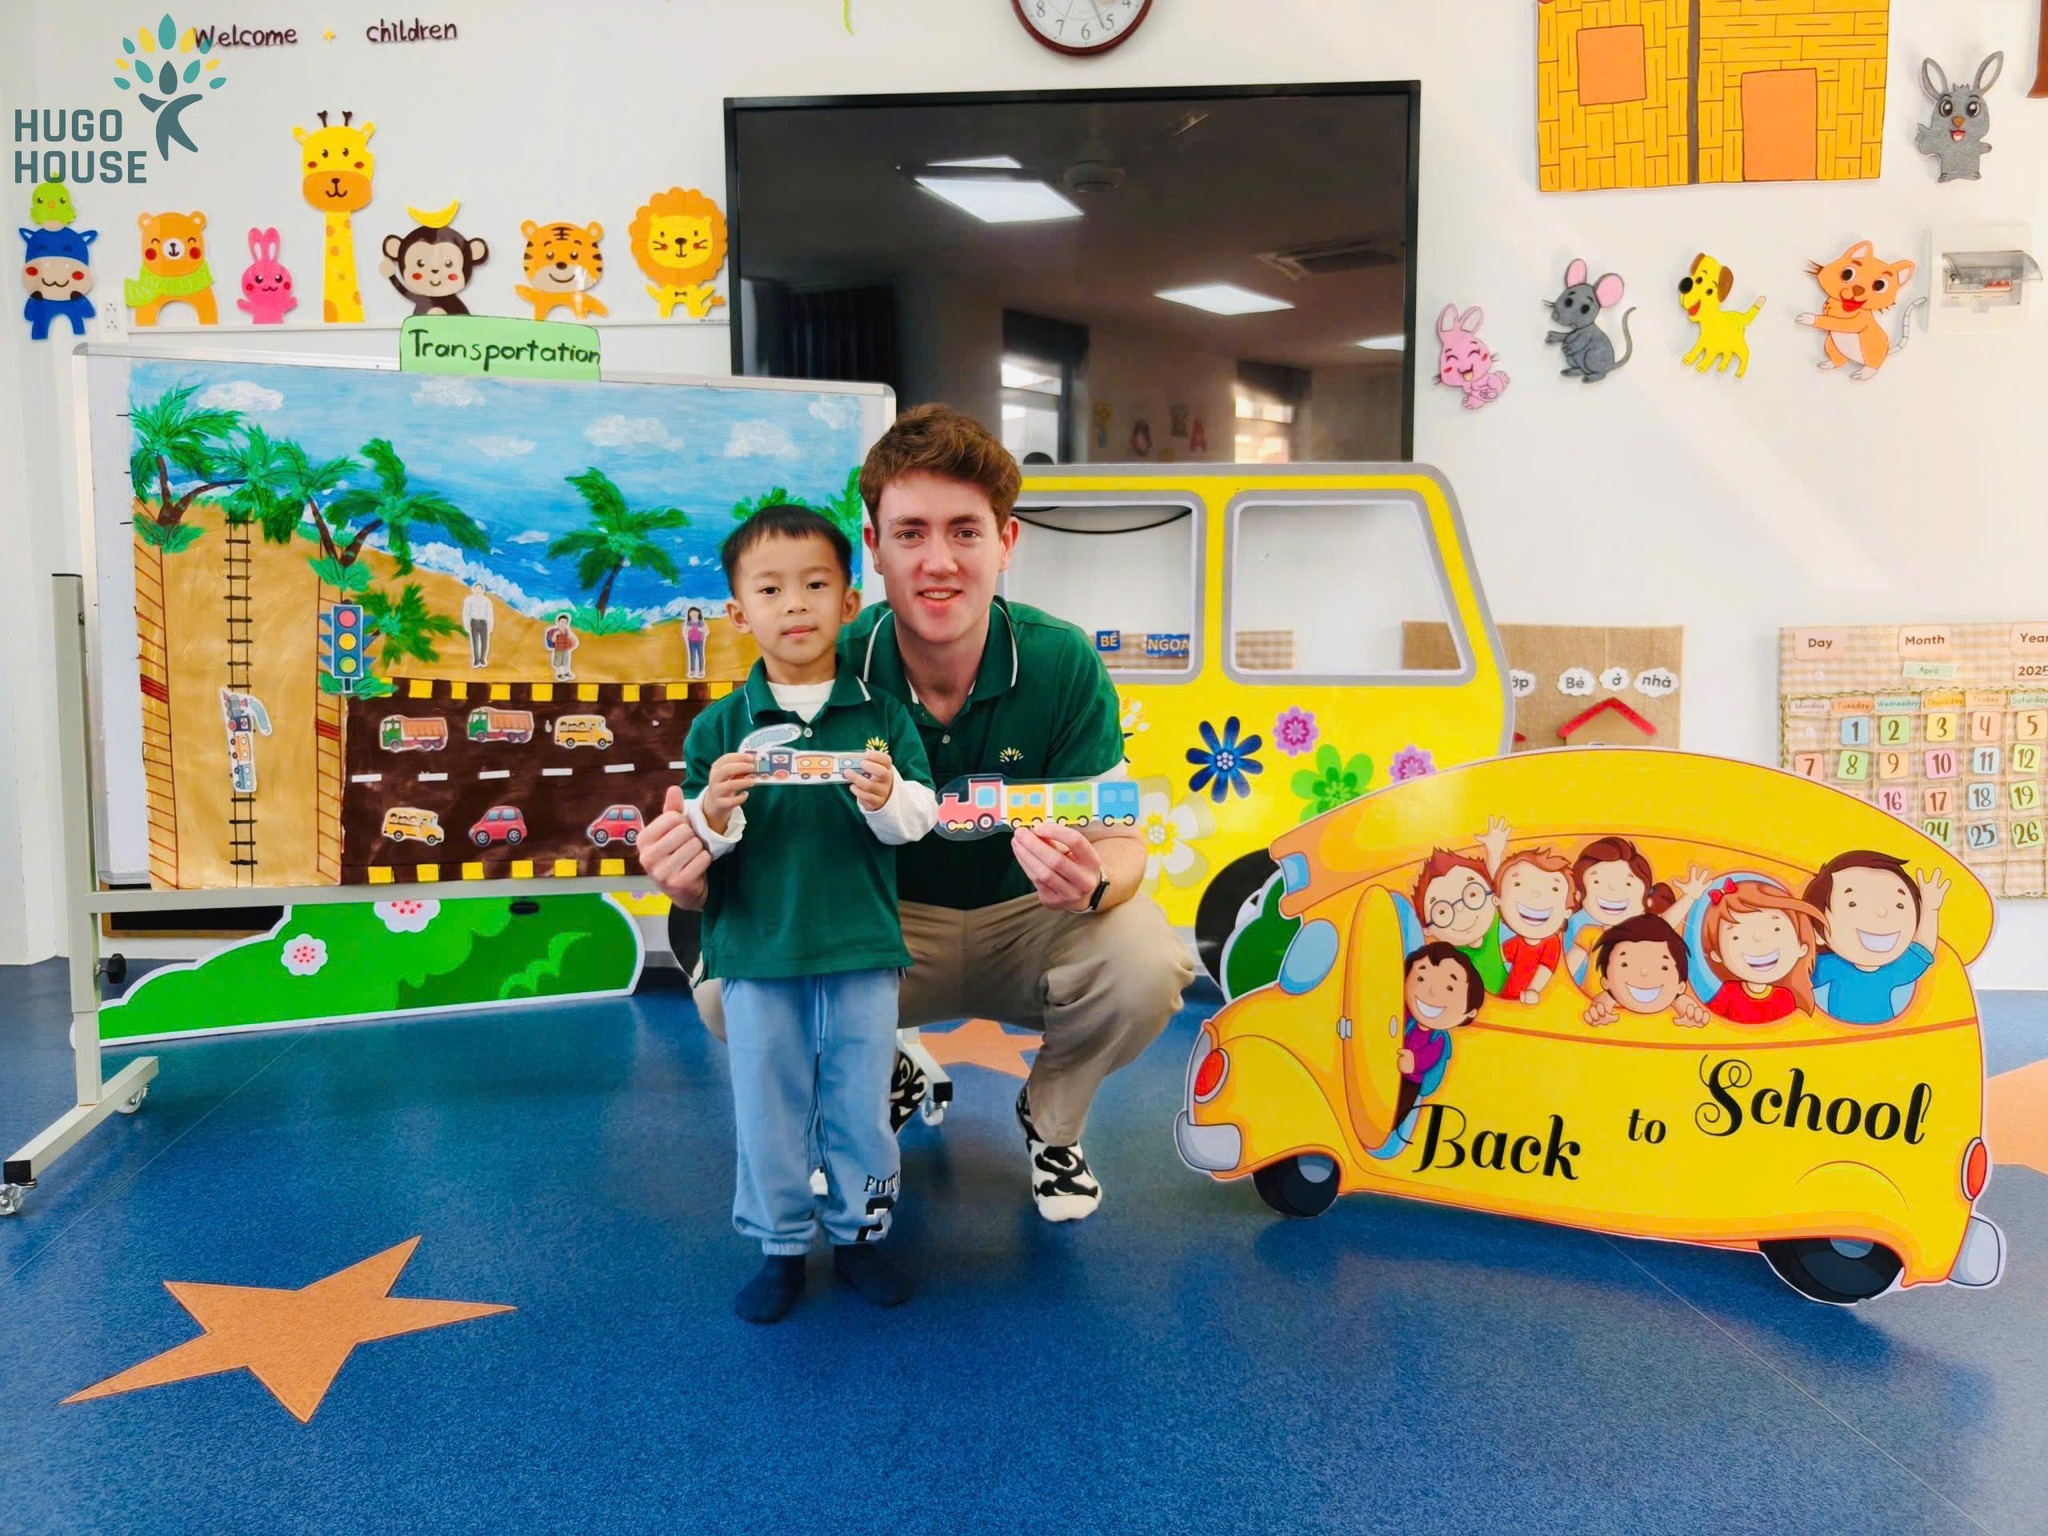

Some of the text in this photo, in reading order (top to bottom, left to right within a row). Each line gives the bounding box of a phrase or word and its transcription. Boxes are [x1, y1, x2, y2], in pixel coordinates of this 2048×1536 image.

[1036, 0, 1046, 18] 8
[1055, 19, 1065, 37] 7
[1105, 14, 1115, 31] 5
[193, 18, 458, 48] Welcome children
[1081, 23, 1091, 41] 6
[408, 329, 600, 372] Transportation
[1100, 632, 1118, 647] BÉ
[1807, 637, 1833, 650] Day
[1905, 634, 1945, 646] Month
[1918, 666, 1939, 676] April
[1512, 675, 1529, 691] ớp
[1566, 676, 1585, 689] Bé
[1642, 674, 1672, 689] nhà
[1838, 701, 1870, 711] Tuesday
[1877, 698, 1920, 708] Wednesday
[1972, 695, 2000, 704] Friday
[1851, 714, 2039, 742] 1 2 3 4 5
[1804, 748, 2036, 776] 7 8 9 10 11 12
[1884, 785, 2034, 812] 16 17 18 19
[1925, 821, 2039, 846] 24 25 26
[1395, 1053, 1933, 1181] Back to School
